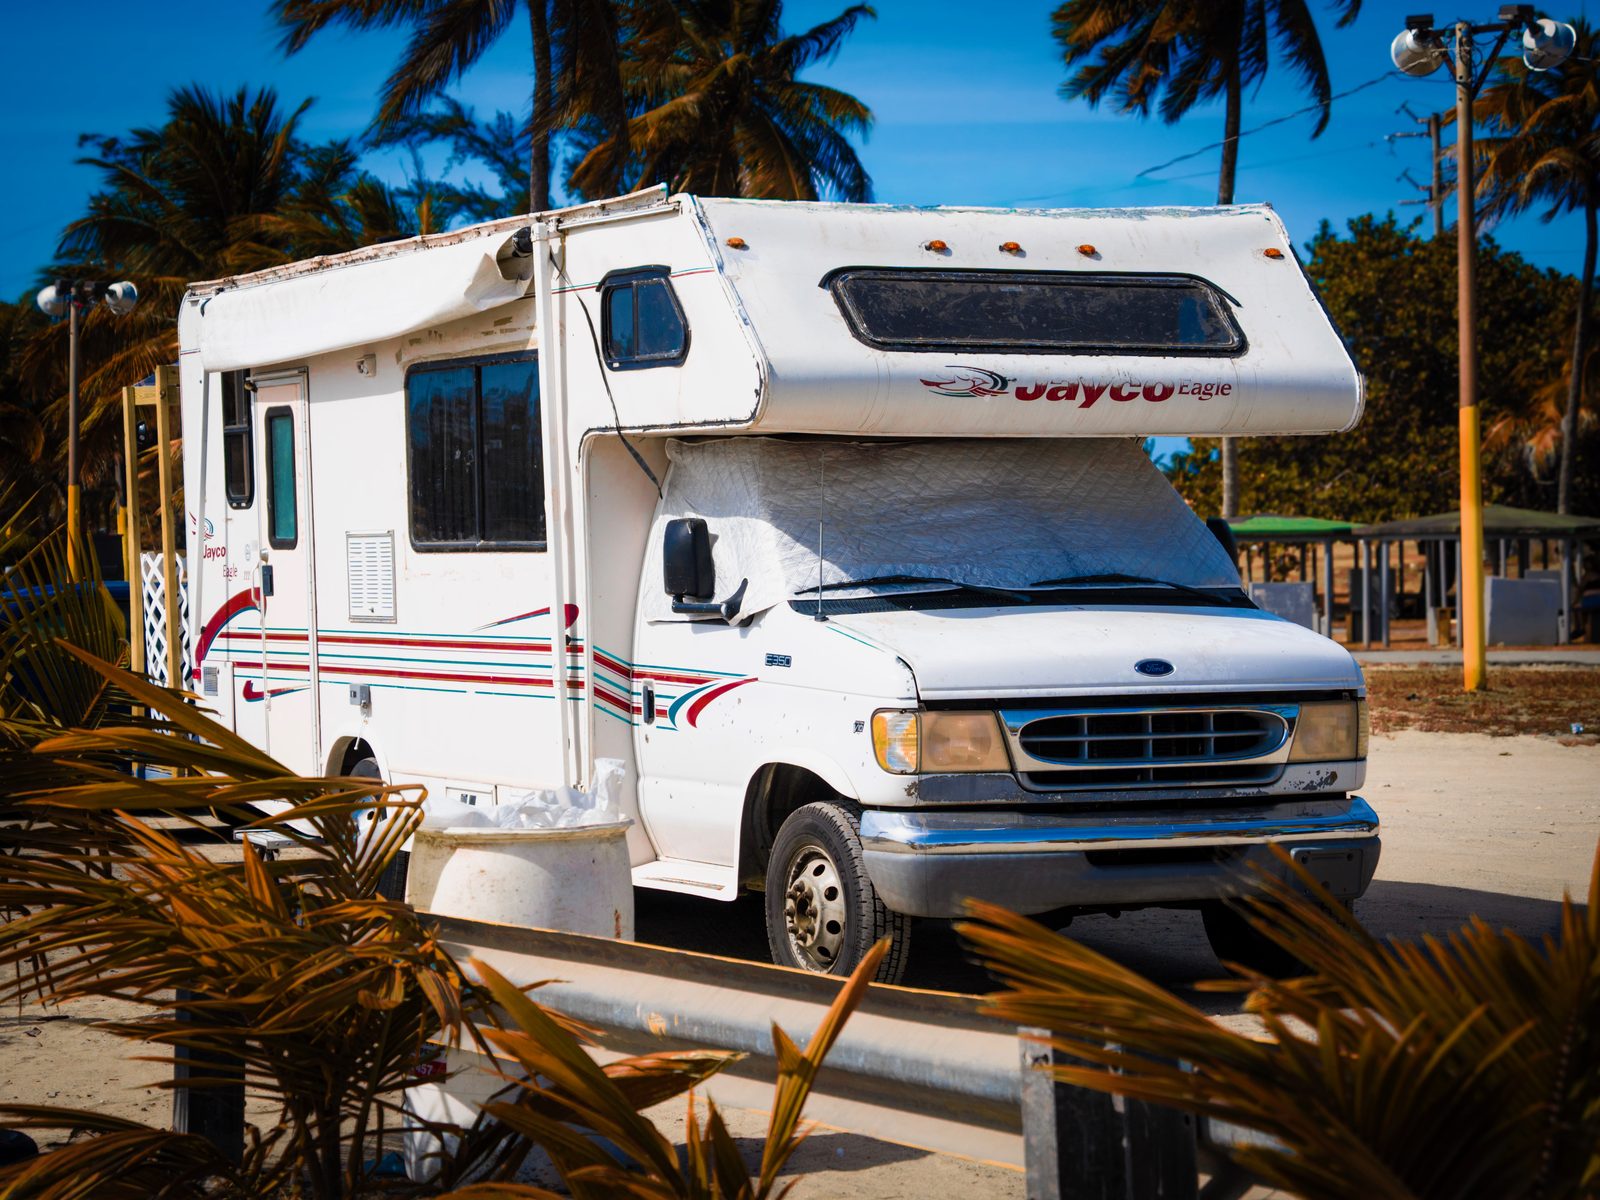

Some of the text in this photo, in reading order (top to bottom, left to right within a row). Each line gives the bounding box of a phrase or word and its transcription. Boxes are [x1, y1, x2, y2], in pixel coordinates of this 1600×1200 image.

[1015, 377, 1232, 408] Jayco Eagle
[203, 544, 226, 562] Jayco
[222, 563, 238, 582] Eagle
[765, 653, 792, 668] E350
